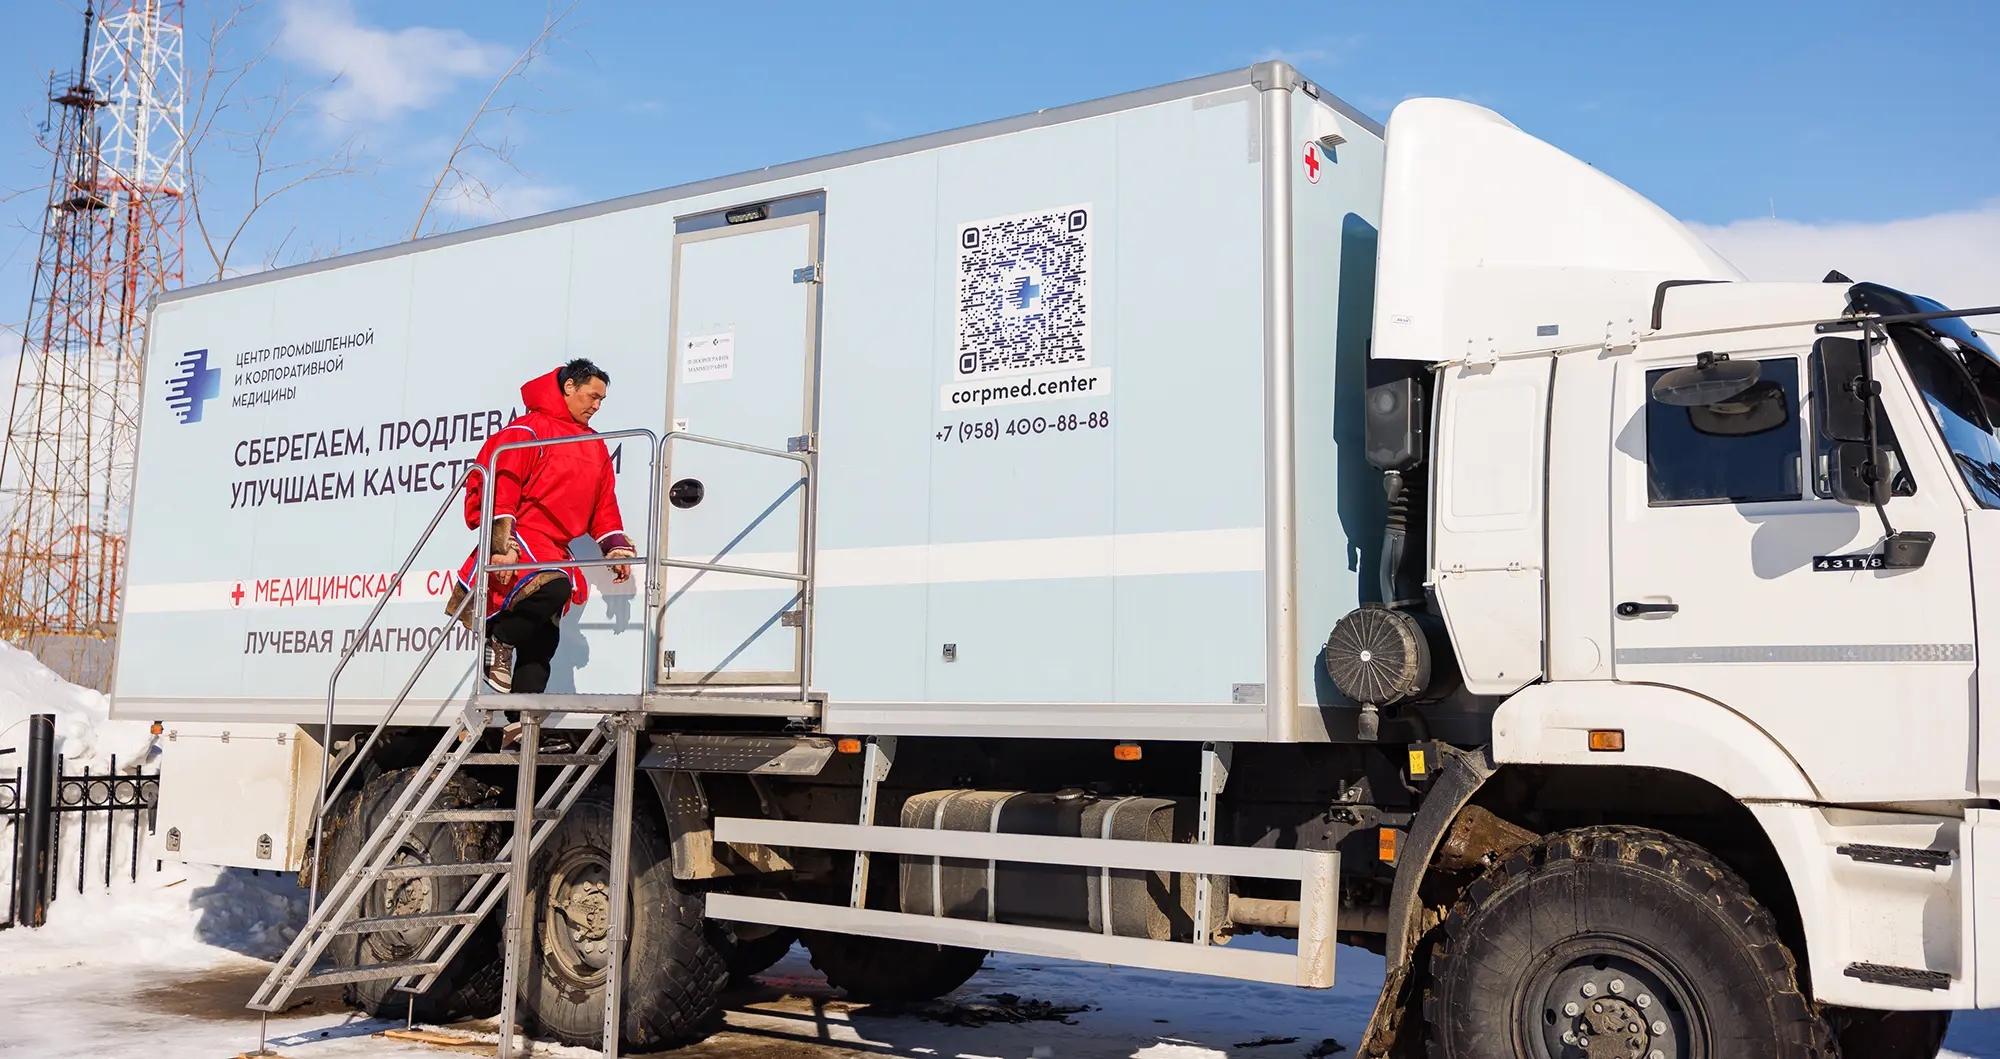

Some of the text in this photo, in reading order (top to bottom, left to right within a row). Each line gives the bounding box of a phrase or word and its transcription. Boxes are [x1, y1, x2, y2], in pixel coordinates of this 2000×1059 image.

[236, 327, 375, 368] ЦЕНТР ПРОМЫШЛЕННОЙ
[234, 354, 345, 387] И КОРПОРАТИВНОЙ
[232, 386, 297, 409] МЕДИЦИНЫ
[951, 375, 1098, 405] corpmed.center
[234, 406, 530, 467] СБЕРЕГАЕМ, ПРОДЛЕВ
[936, 410, 1109, 443] +7 (958) 400-88-88
[230, 470, 355, 509] УЛУЧШАЕМ
[1818, 558, 1882, 569] 43118
[255, 573, 402, 607] МЕДИЦИНСКАЯ
[244, 630, 334, 654] ЛУЧЕВАЯ
